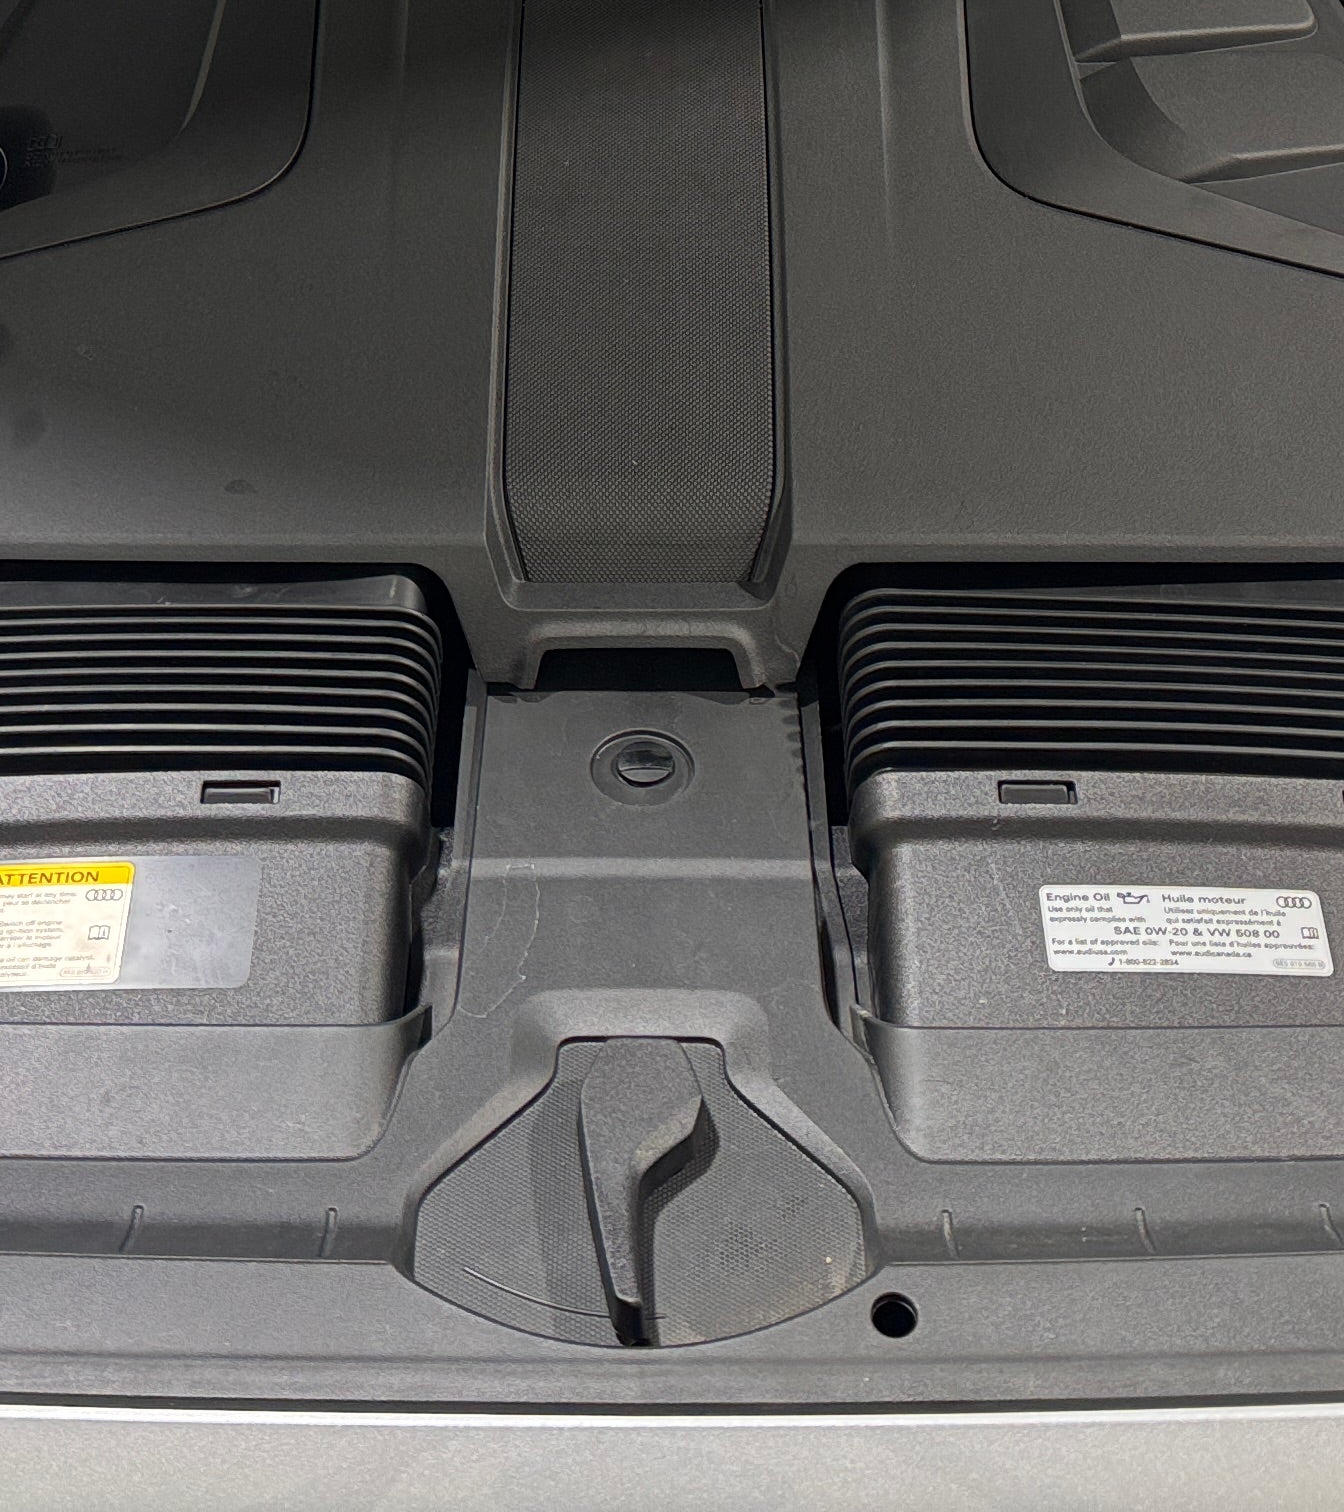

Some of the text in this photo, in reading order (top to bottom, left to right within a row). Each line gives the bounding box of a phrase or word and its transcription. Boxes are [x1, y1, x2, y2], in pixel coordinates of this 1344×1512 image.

[1046, 892, 1111, 903] Engine Oil
[1162, 894, 1246, 904] Huile moteur
[1047, 905, 1113, 914] Use only oil that
[1196, 908, 1246, 916] uniquement
[1049, 915, 1087, 924] expressly
[1089, 915, 1127, 924] complies
[1165, 917, 1179, 925] qui
[1113, 926, 1280, 938] SAE 0W-20 & VW 508 00
[1052, 937, 1065, 946] For
[1075, 937, 1088, 946] list
[1089, 937, 1098, 946] of
[1100, 938, 1140, 947] approved
